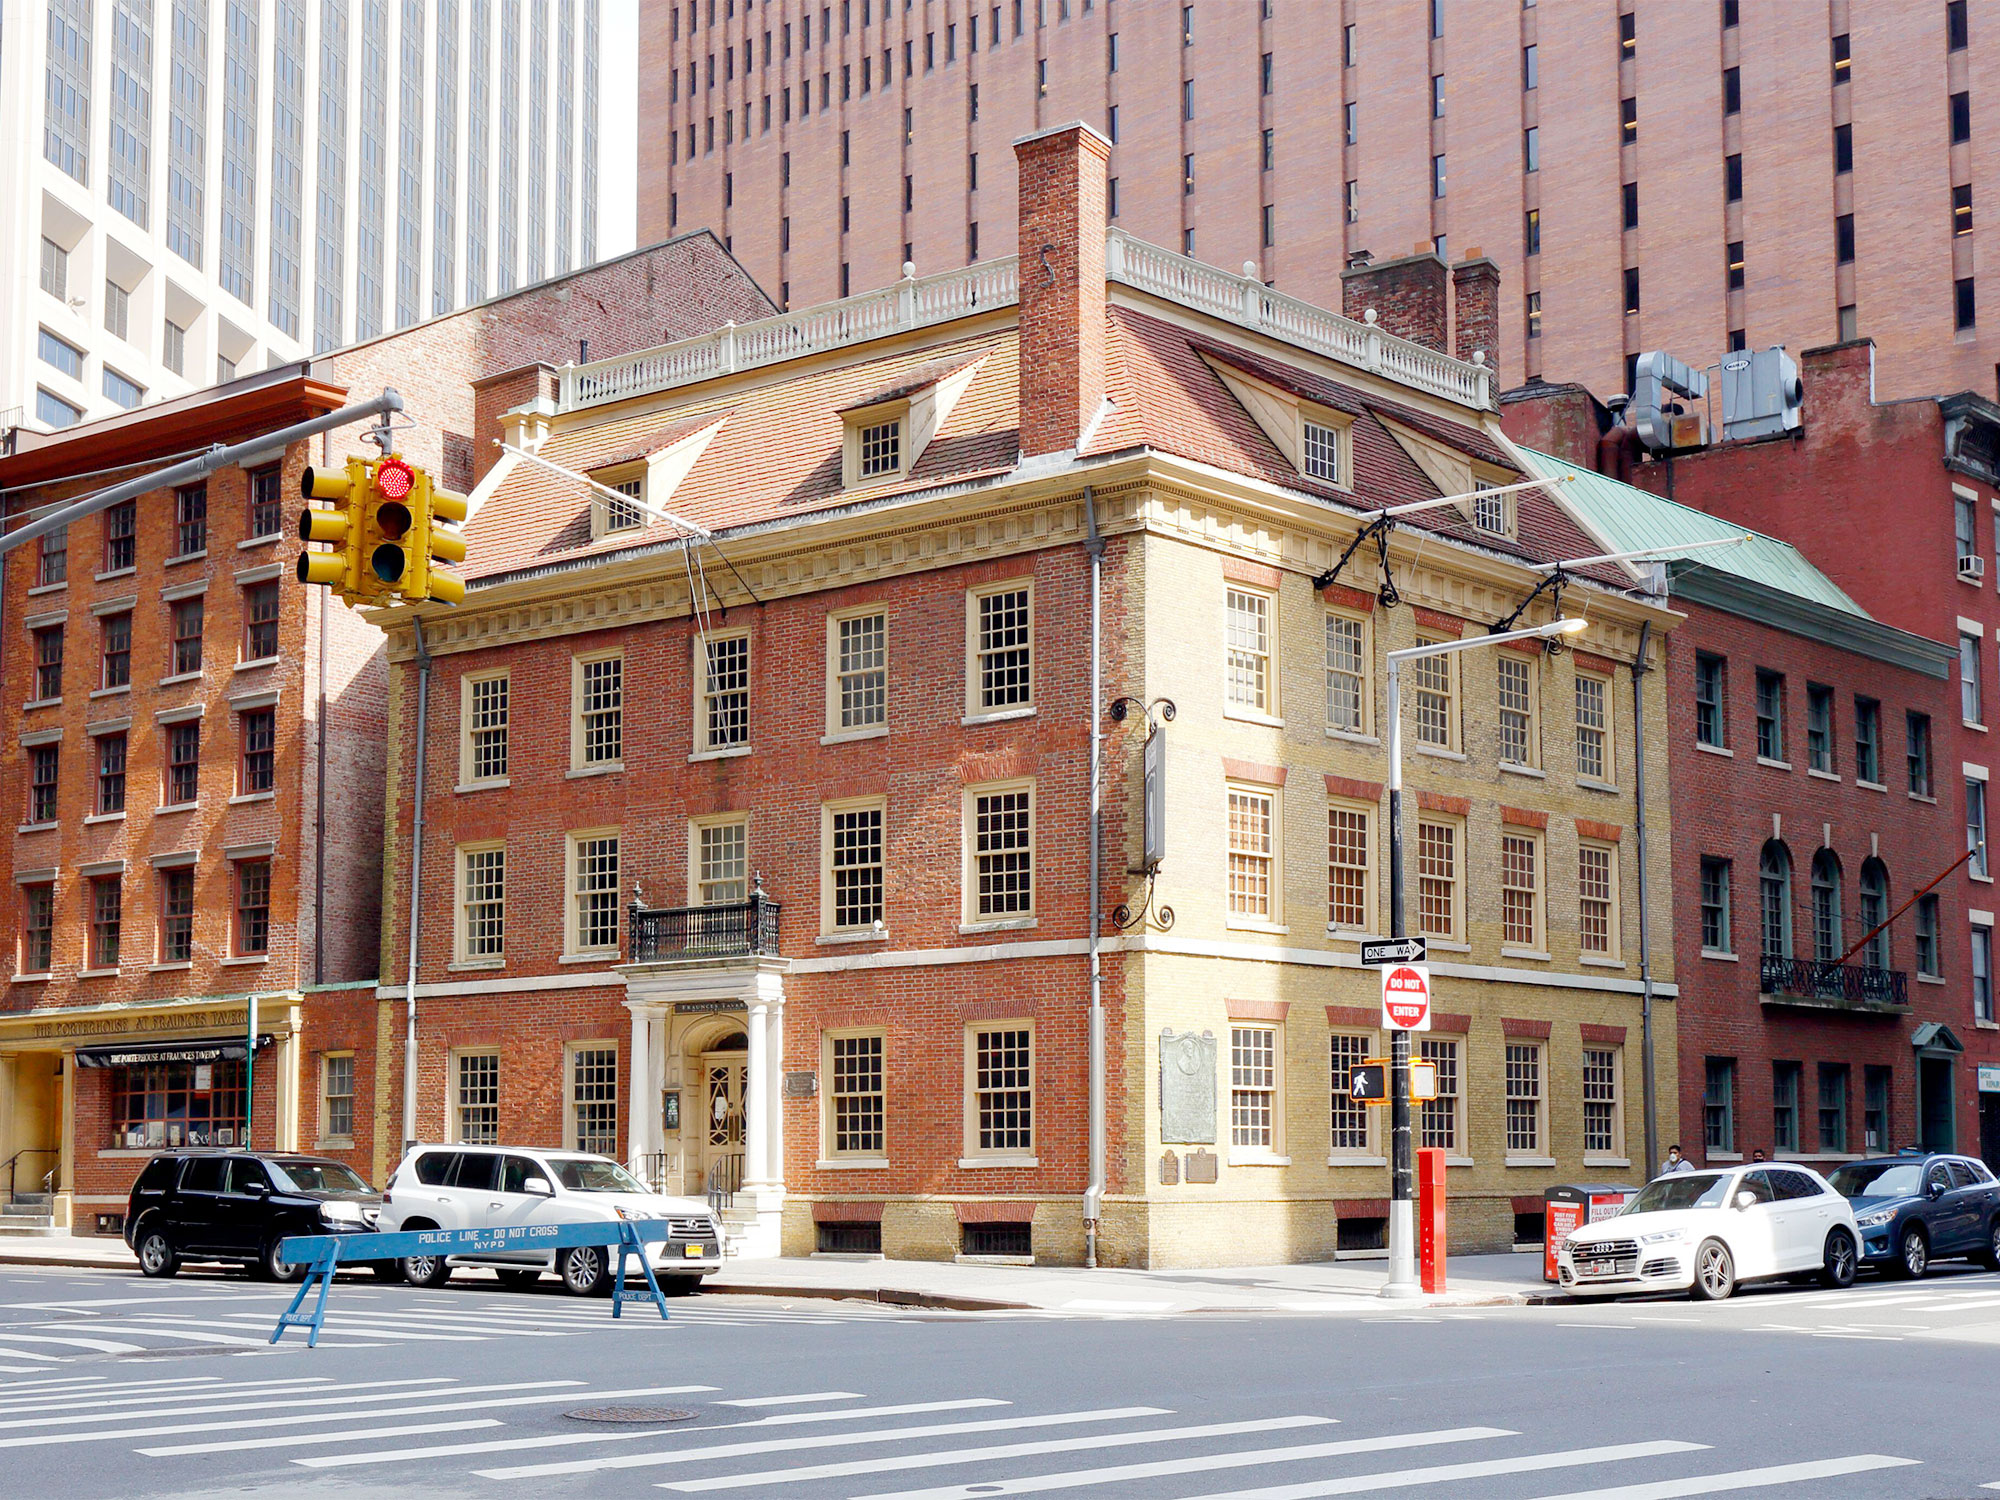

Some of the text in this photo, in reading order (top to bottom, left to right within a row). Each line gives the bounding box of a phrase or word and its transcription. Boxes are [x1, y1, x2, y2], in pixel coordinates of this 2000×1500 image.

[1366, 945, 1417, 958] ONE WAY
[1390, 978, 1421, 990] DO NOT
[1393, 1005, 1419, 1017] ENTER
[34, 1024, 52, 1037] THE
[56, 1018, 128, 1036] PORTERHOUSE
[135, 1016, 149, 1031] AT
[153, 1012, 207, 1030] FRAUNCES
[110, 1054, 121, 1063] THE
[121, 1053, 159, 1063] PORTERHOUSE
[160, 1052, 166, 1061] AT
[166, 1051, 195, 1061] FRAUNCES
[1591, 1208, 1602, 1216] FILL
[418, 1232, 452, 1244] POLICE
[459, 1230, 480, 1242] LINE
[493, 1229, 506, 1239] DO
[508, 1227, 527, 1239] NOT
[529, 1225, 559, 1237] CROSS
[473, 1240, 505, 1250] NYPD
[619, 1292, 637, 1300] POLICE
[284, 1313, 300, 1321] POLICE
